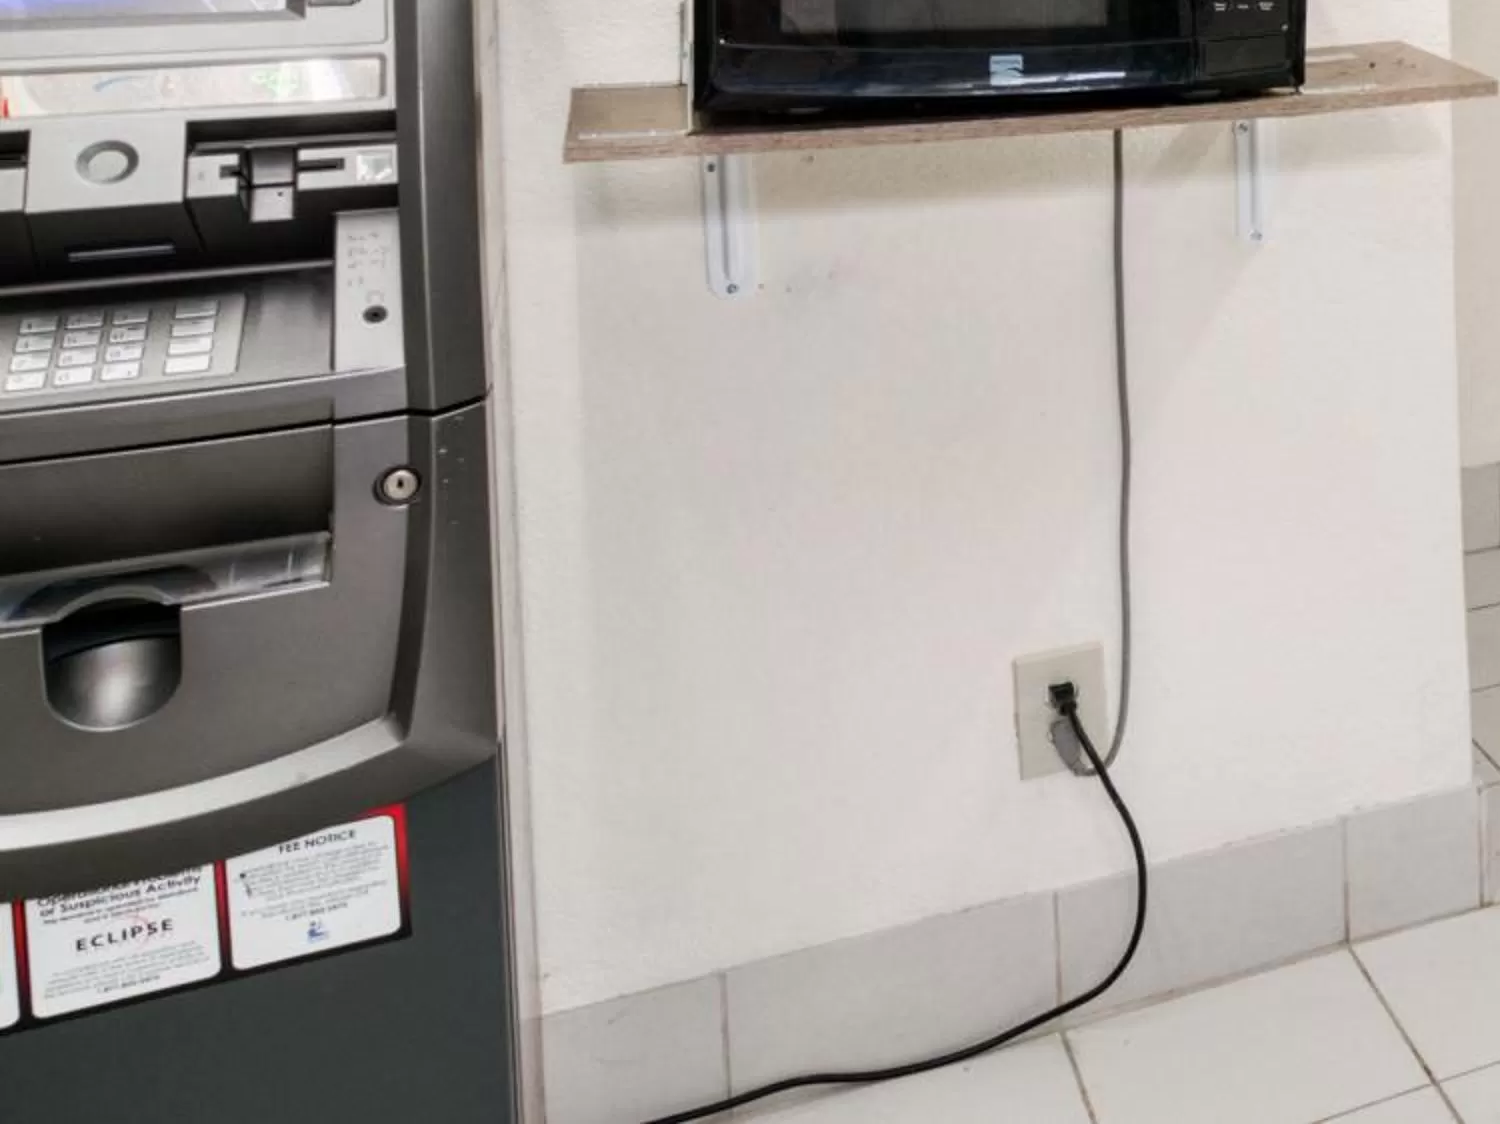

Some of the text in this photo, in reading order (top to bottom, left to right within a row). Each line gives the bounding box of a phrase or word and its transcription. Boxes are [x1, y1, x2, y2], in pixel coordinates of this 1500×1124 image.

[279, 829, 356, 855] FEE NOTICE
[60, 889, 142, 913] Suspicious
[146, 875, 201, 893] Activity
[75, 918, 174, 952] ECLIPSE
